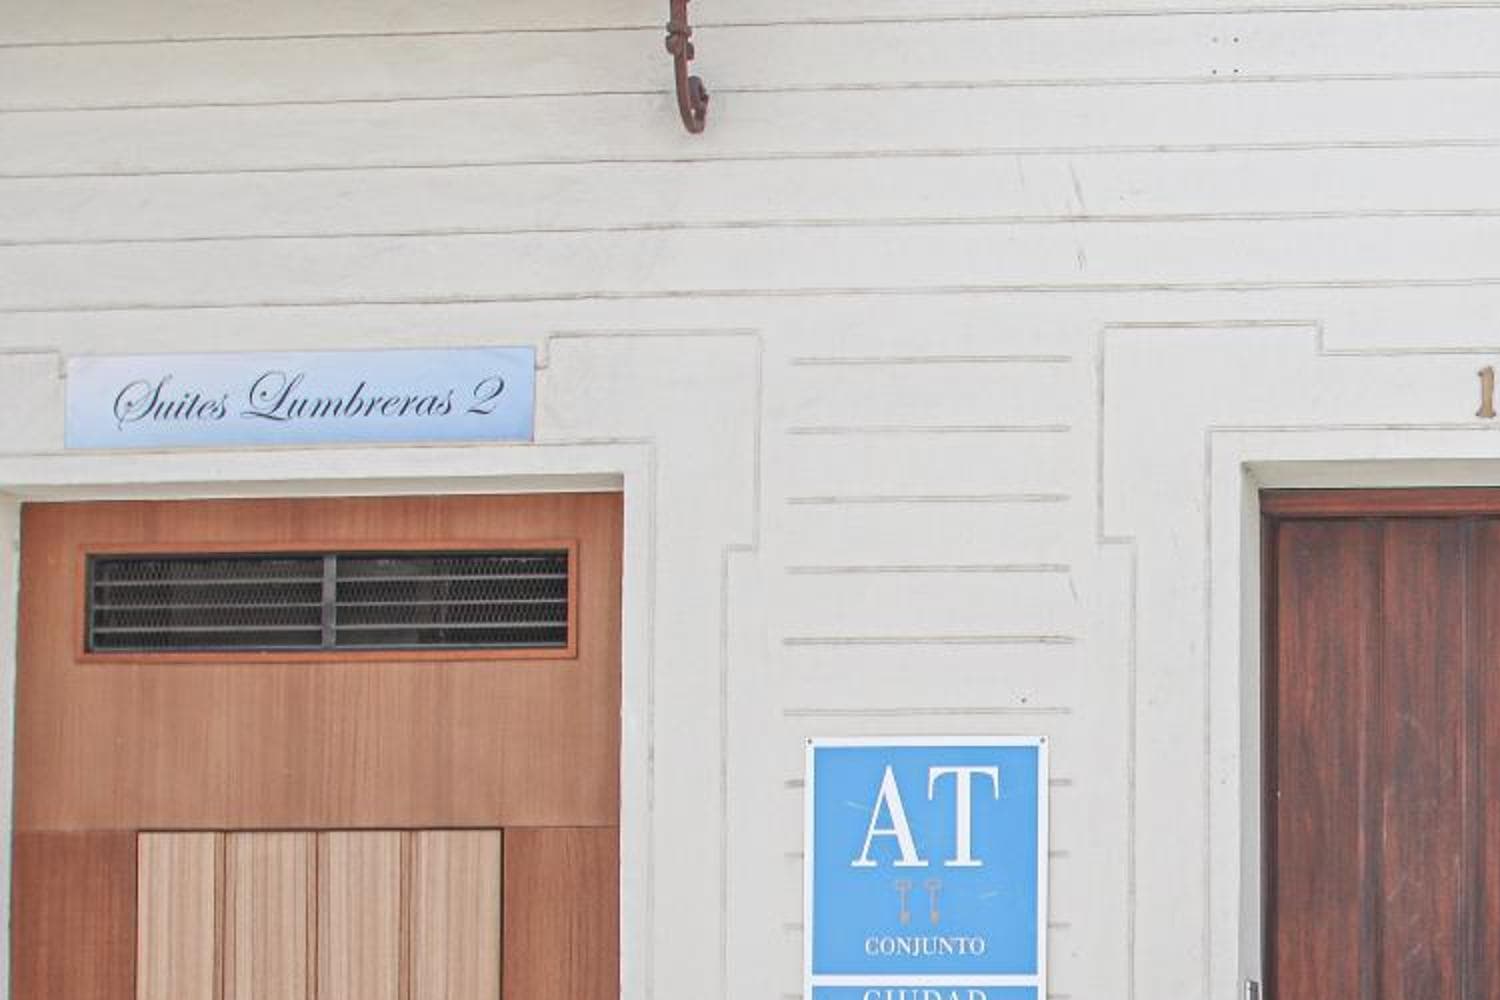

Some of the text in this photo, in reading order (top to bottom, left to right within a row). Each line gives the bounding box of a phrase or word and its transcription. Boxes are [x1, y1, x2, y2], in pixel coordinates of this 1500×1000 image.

[114, 372, 505, 431] Suites Lumbreras 2
[850, 765, 999, 867] AT
[865, 936, 985, 957] CONJUNTO
